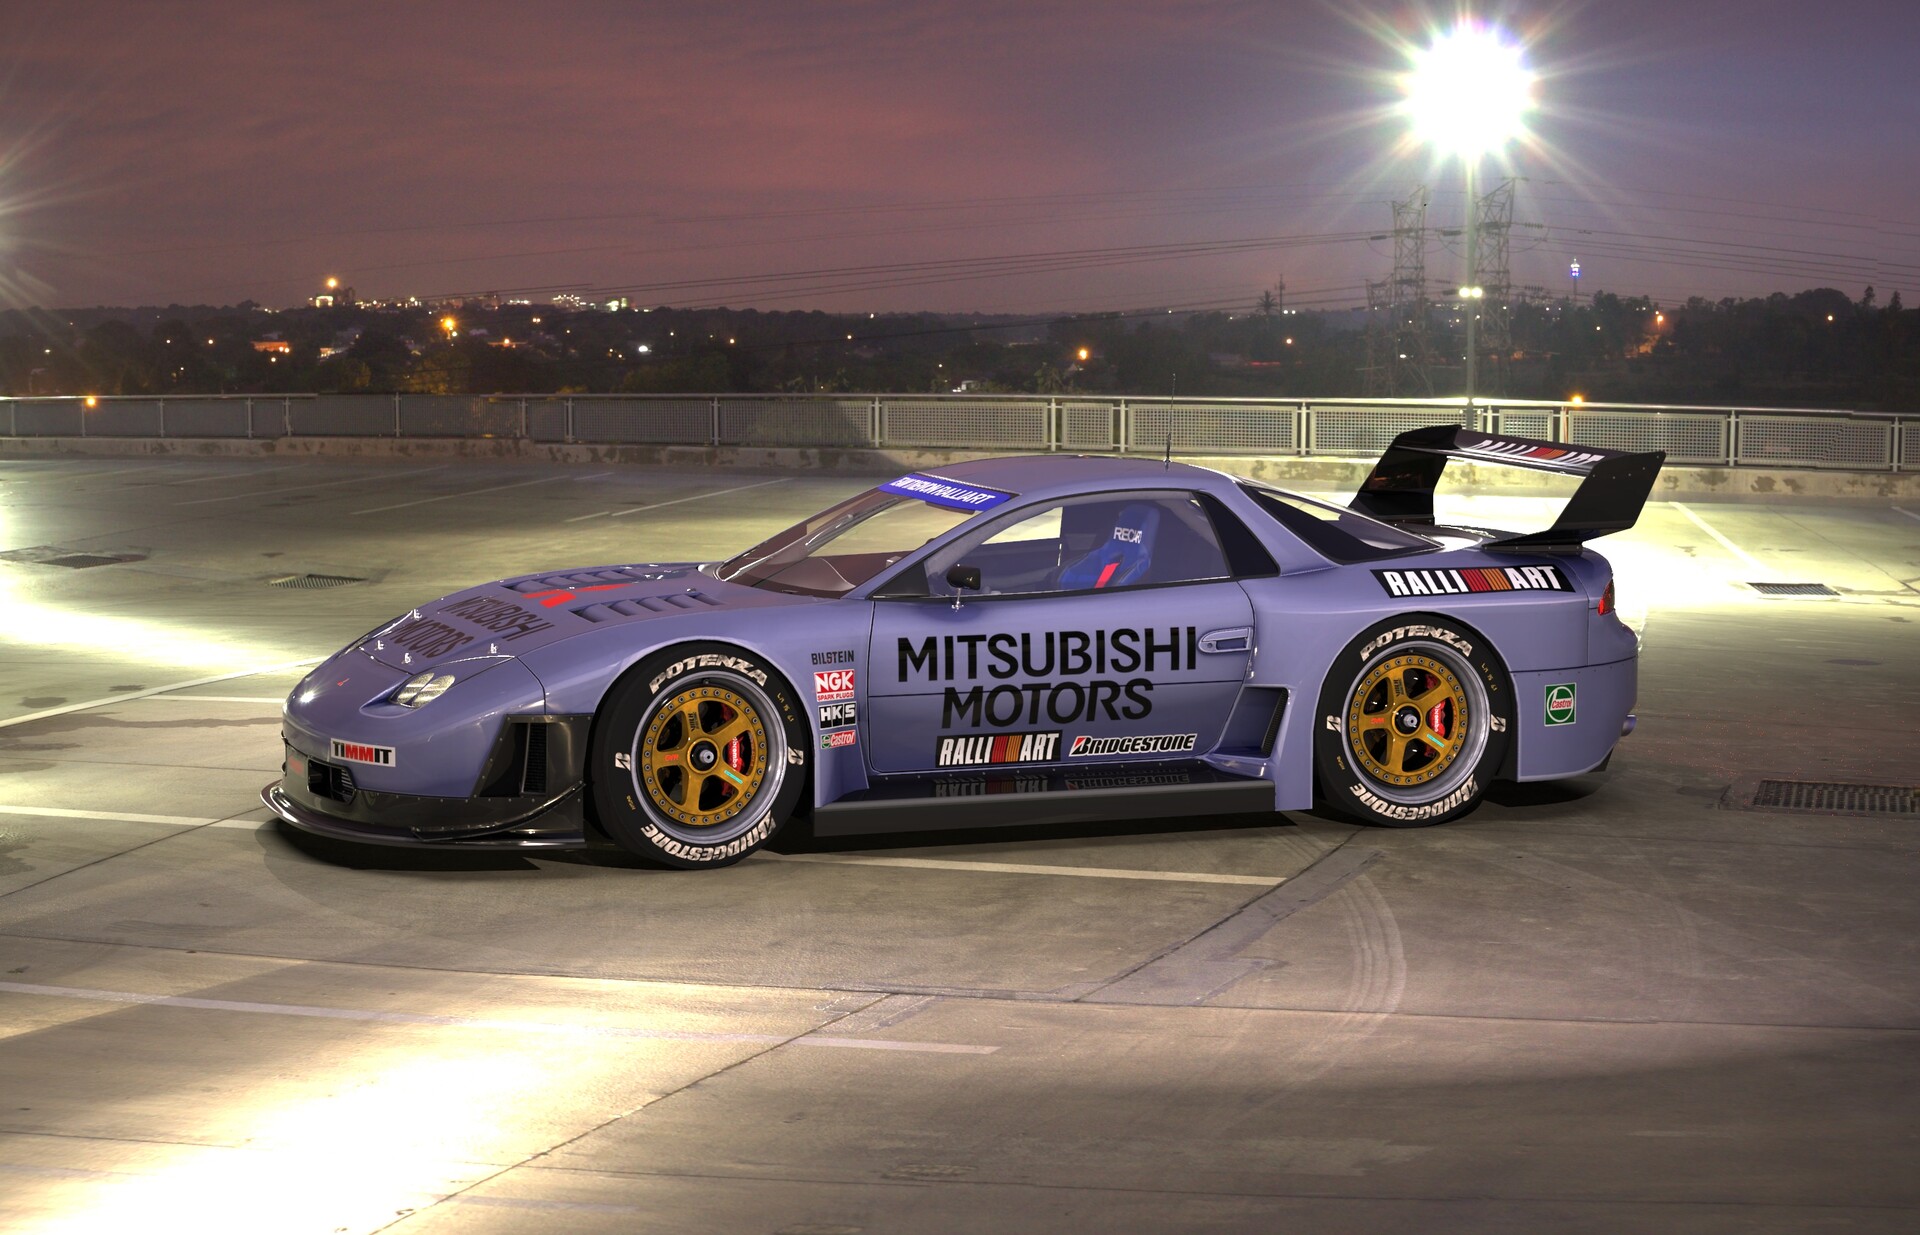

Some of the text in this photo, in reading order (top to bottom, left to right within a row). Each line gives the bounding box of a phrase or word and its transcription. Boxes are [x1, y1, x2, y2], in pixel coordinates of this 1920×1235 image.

[1382, 566, 1562, 596] RALLI ART
[811, 650, 855, 665] BILSTEIN
[897, 626, 1196, 682] MITSUBISHI
[1360, 625, 1473, 662] POTENZA
[649, 653, 768, 694] POTENZA
[815, 670, 854, 693] NGK
[817, 691, 854, 701] SPARK PLUGS
[941, 678, 1154, 728] MOTORS
[820, 703, 855, 722] HKS
[332, 741, 392, 764] TIMMIT
[830, 731, 855, 747] Castrol
[938, 733, 1060, 766] RALLI ART
[1069, 734, 1196, 757] BRIDGESTONE
[1350, 773, 1480, 821] BRIDGESTONE
[640, 810, 778, 861] BRIDGESTONE
